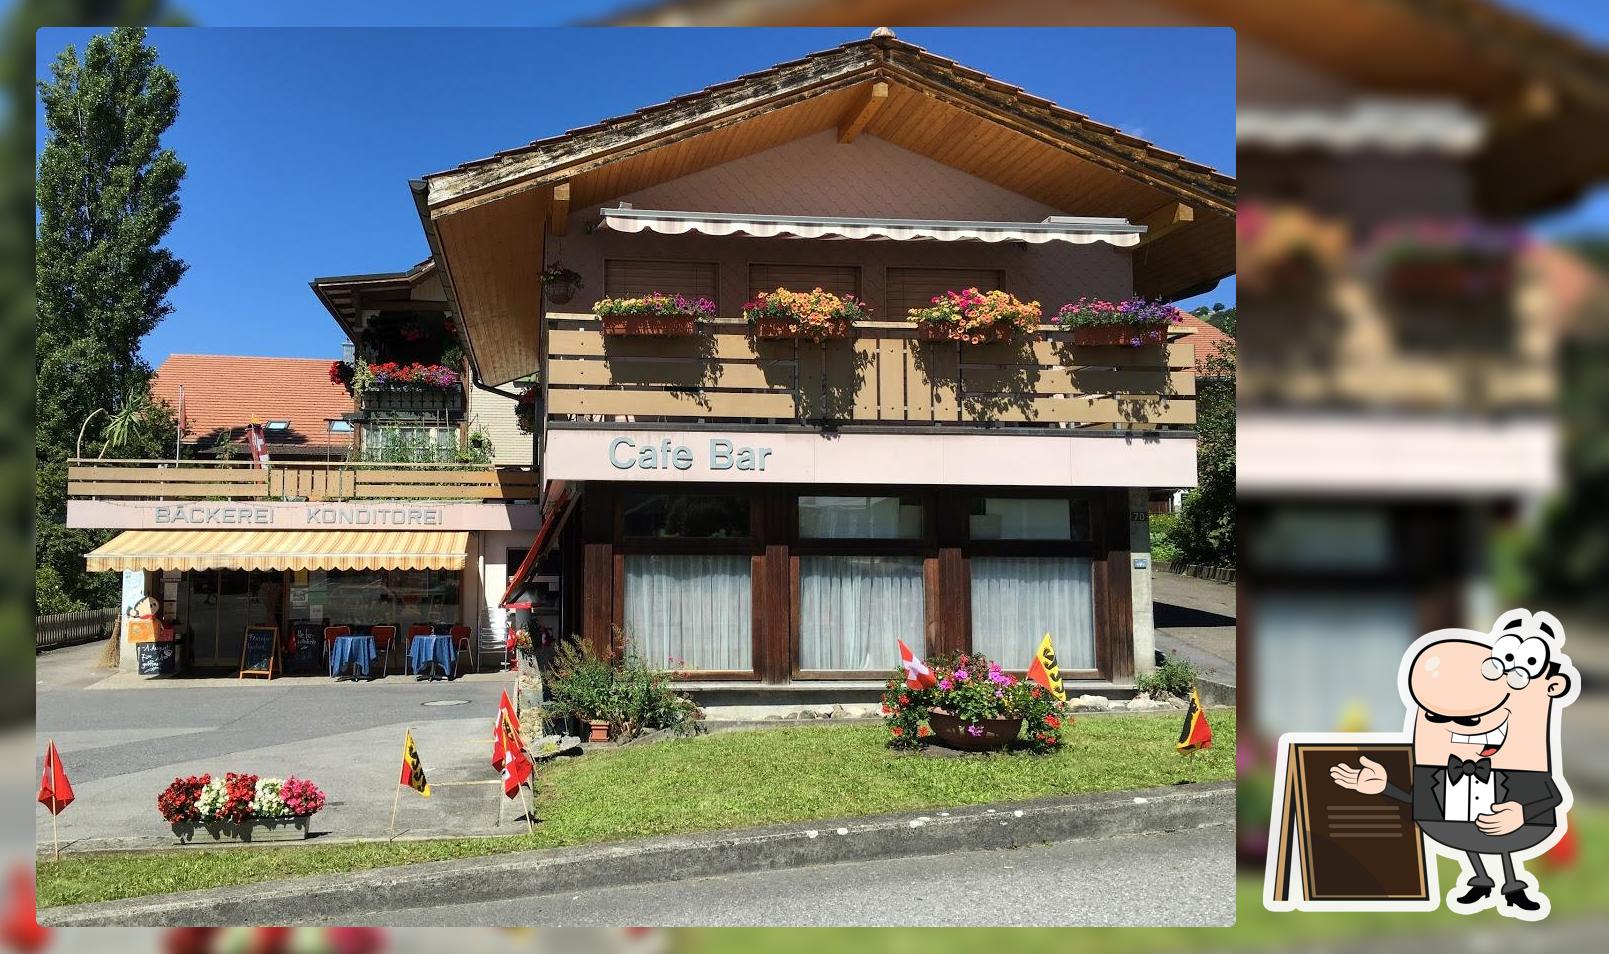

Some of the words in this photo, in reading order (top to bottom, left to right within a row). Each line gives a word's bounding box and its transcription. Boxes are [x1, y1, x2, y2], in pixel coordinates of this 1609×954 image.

[608, 436, 694, 471] Cafe
[709, 438, 773, 472] Bar
[155, 505, 275, 524] BÄCKEREI
[306, 508, 443, 525] KONDITOREI
[1133, 512, 1145, 521] 70
